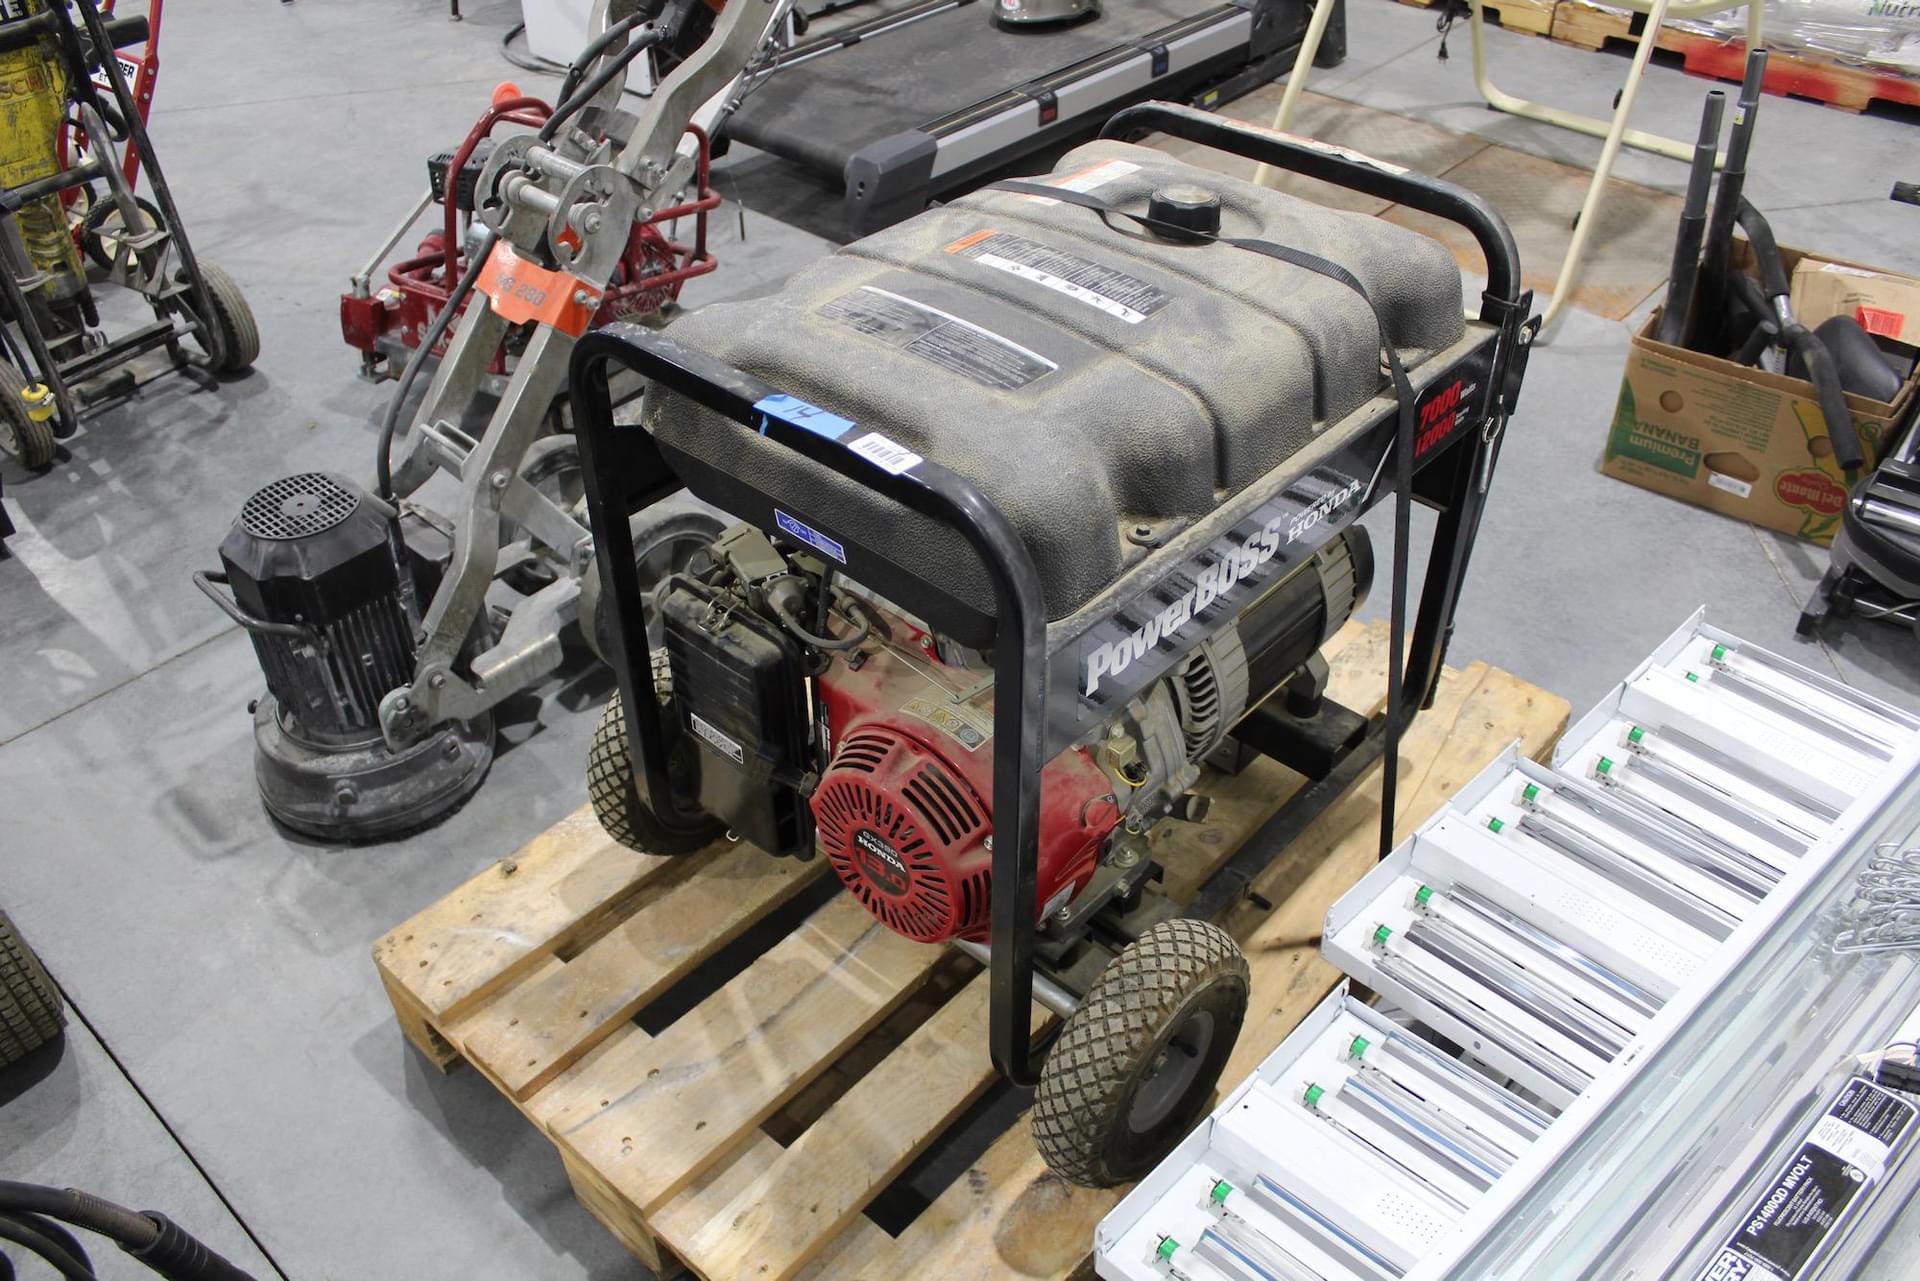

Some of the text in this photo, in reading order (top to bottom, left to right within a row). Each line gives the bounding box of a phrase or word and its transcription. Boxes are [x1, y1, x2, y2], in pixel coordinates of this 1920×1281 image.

[783, 404, 824, 421] 14
[1420, 379, 1462, 430] 7000
[1414, 410, 1457, 458] 12000
[1629, 434, 1697, 466] Premium
[1630, 418, 1700, 450] BANANA
[1287, 480, 1361, 545] HONDA
[1779, 481, 1843, 508] Del Monte
[1086, 515, 1281, 698] PowerBOSS
[857, 835, 906, 873] HONDA
[1746, 1186, 1789, 1237] PS1400QD
[1782, 1154, 1813, 1190] MVOLT
